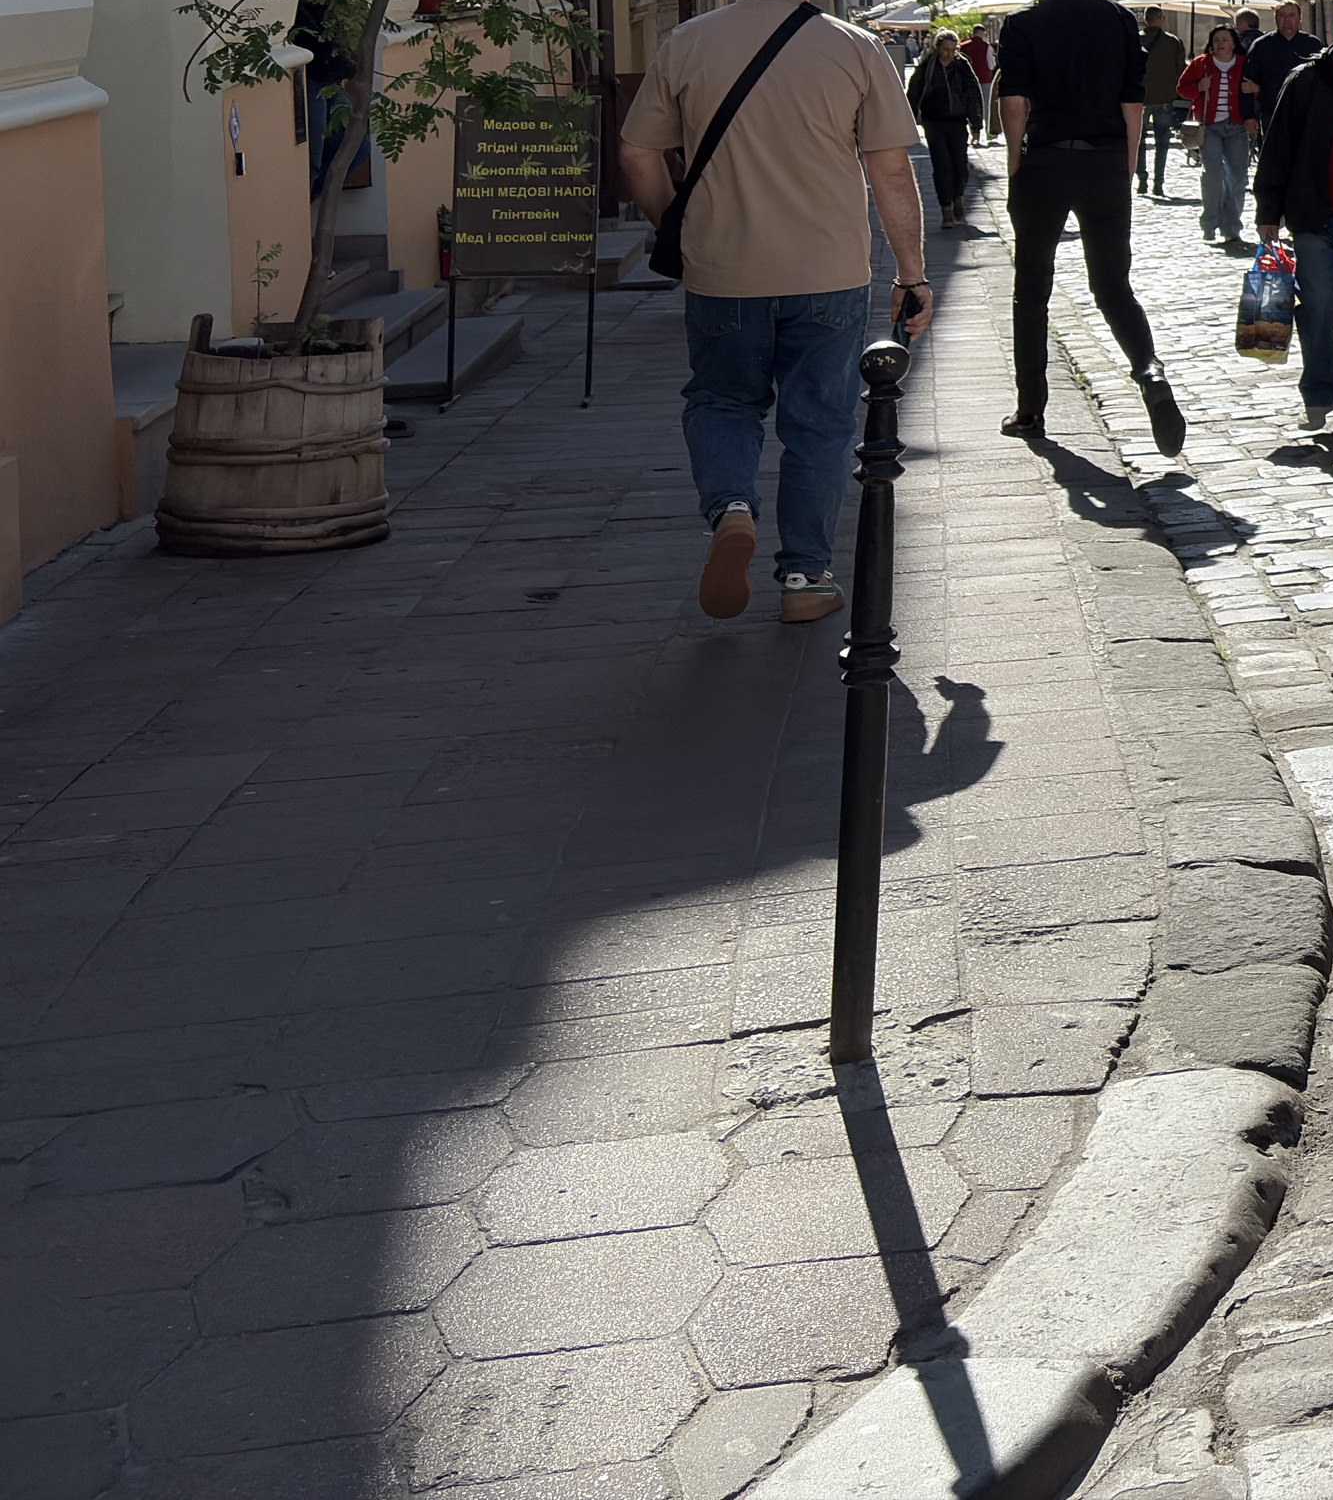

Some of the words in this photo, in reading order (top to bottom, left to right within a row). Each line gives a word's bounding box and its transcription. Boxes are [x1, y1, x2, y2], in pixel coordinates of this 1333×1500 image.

[483, 118, 536, 132] Медове
[476, 142, 518, 154] Ягідні
[521, 143, 578, 153] наливки
[472, 165, 548, 177] Конопляна
[551, 166, 582, 176] кава
[456, 187, 494, 199] МІЦНІ
[498, 186, 551, 199] МЕДОВІ
[554, 184, 596, 197] НАПОЇ
[491, 208, 560, 220] Глінтвейн
[455, 232, 484, 244] Мед
[495, 231, 547, 243] воскові
[550, 231, 594, 242] свічки
